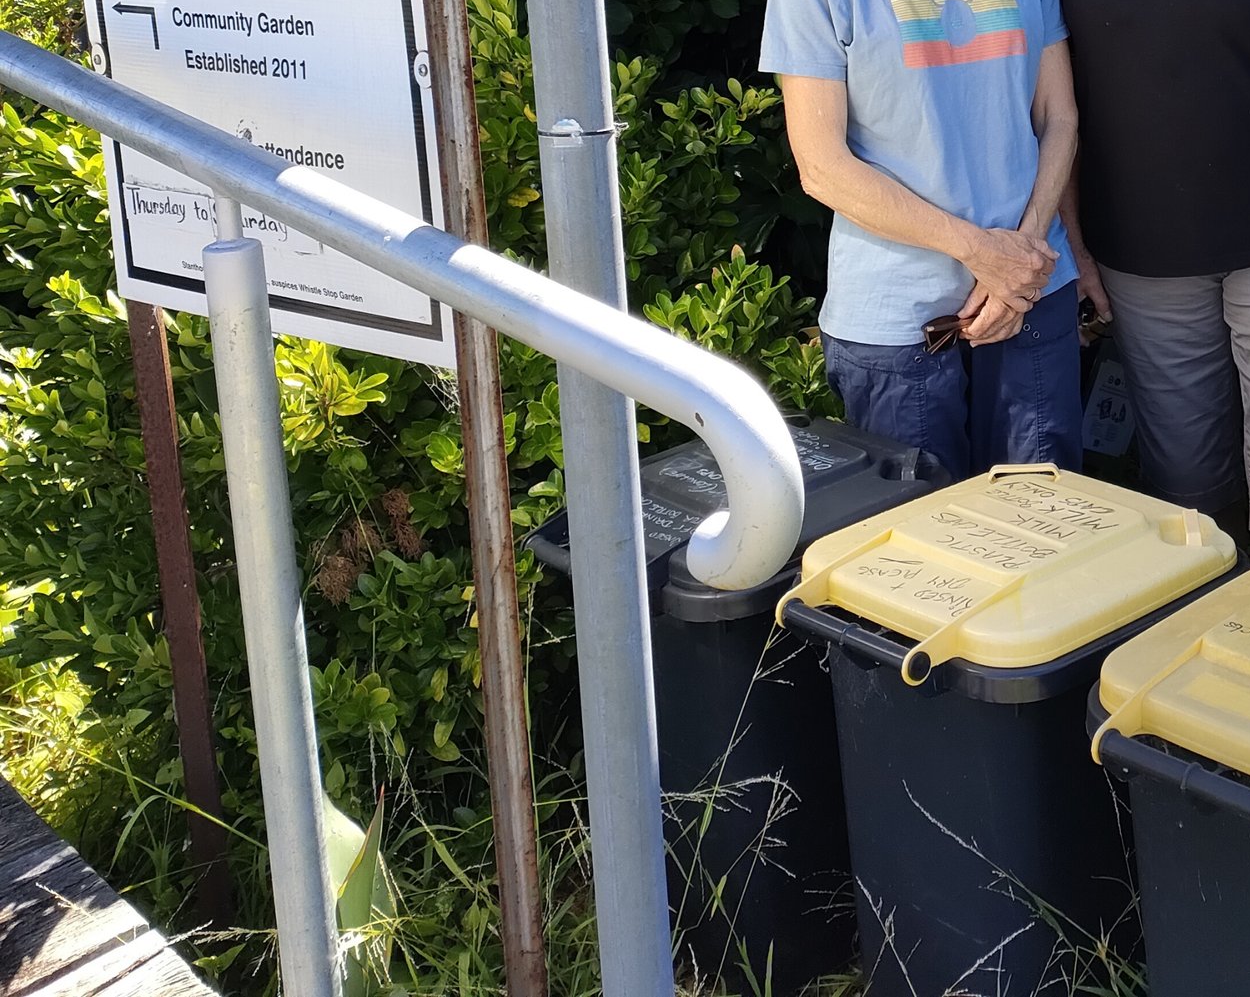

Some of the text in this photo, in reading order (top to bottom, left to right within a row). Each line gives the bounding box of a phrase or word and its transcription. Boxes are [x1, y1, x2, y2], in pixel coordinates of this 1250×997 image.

[172, 7, 315, 37] Community Garden
[185, 49, 307, 80] Established 2011
[126, 187, 186, 223] Thursday
[194, 201, 209, 221] to
[271, 279, 363, 303] auspices Whistle Stop Garden
[1002, 481, 1116, 514] CAPS ONLY
[1016, 513, 1076, 539] MILK
[1040, 505, 1119, 531] MILK
[936, 534, 1028, 569] PLASTIC
[968, 528, 1058, 559] BOTTLE
[927, 575, 972, 590] DRY
